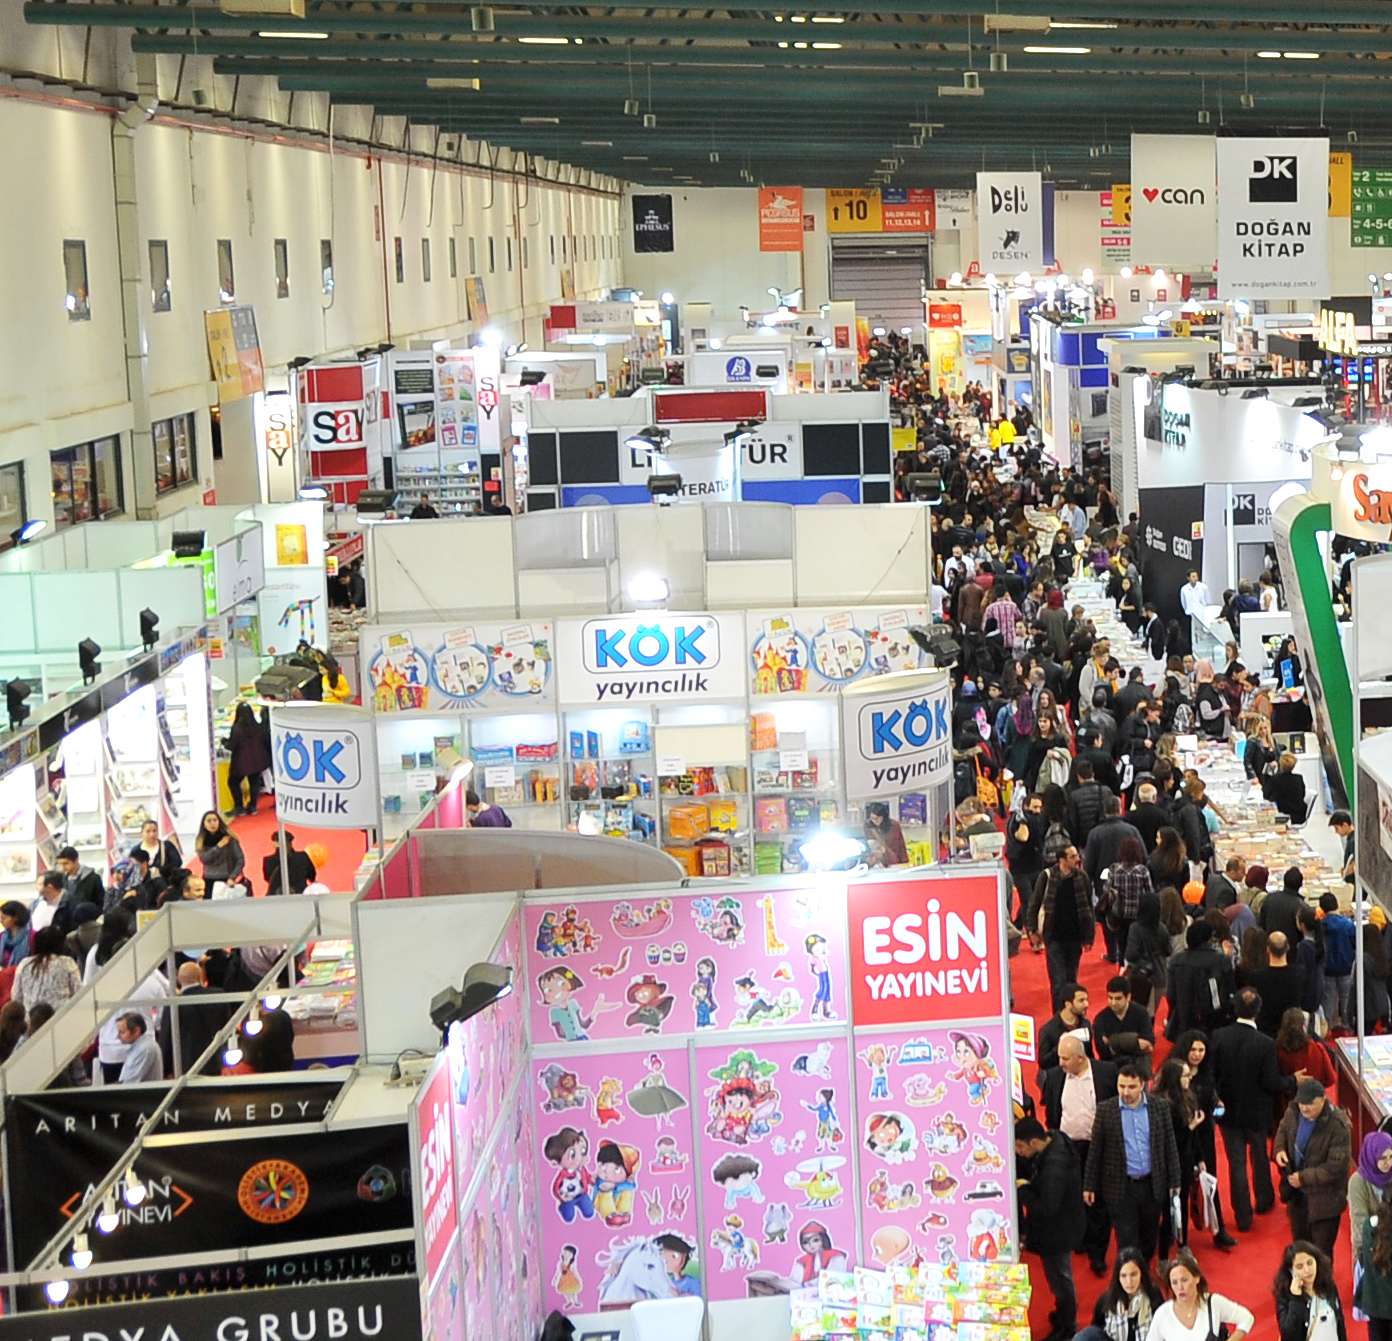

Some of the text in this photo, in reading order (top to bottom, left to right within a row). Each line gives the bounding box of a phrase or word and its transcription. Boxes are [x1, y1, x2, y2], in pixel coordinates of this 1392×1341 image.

[1361, 170, 1370, 181] 2
[1161, 188, 1205, 204] can
[845, 199, 868, 221] 10
[1236, 218, 1311, 236] DOĞAN
[992, 251, 1028, 260] DESEN
[1242, 239, 1305, 257] KİTAP
[594, 623, 707, 668] KÖK
[596, 673, 708, 700] yayıncılık
[871, 696, 948, 754] KÖK
[873, 747, 949, 789] yayıncılık
[863, 899, 988, 966] ESİN
[865, 962, 990, 1001] YAYINEVİ
[35, 1099, 336, 1135] ARITAN MEDYA
[265, 1255, 371, 1278] HOLİSTİK
[216, 1303, 383, 1341] GRUBU
